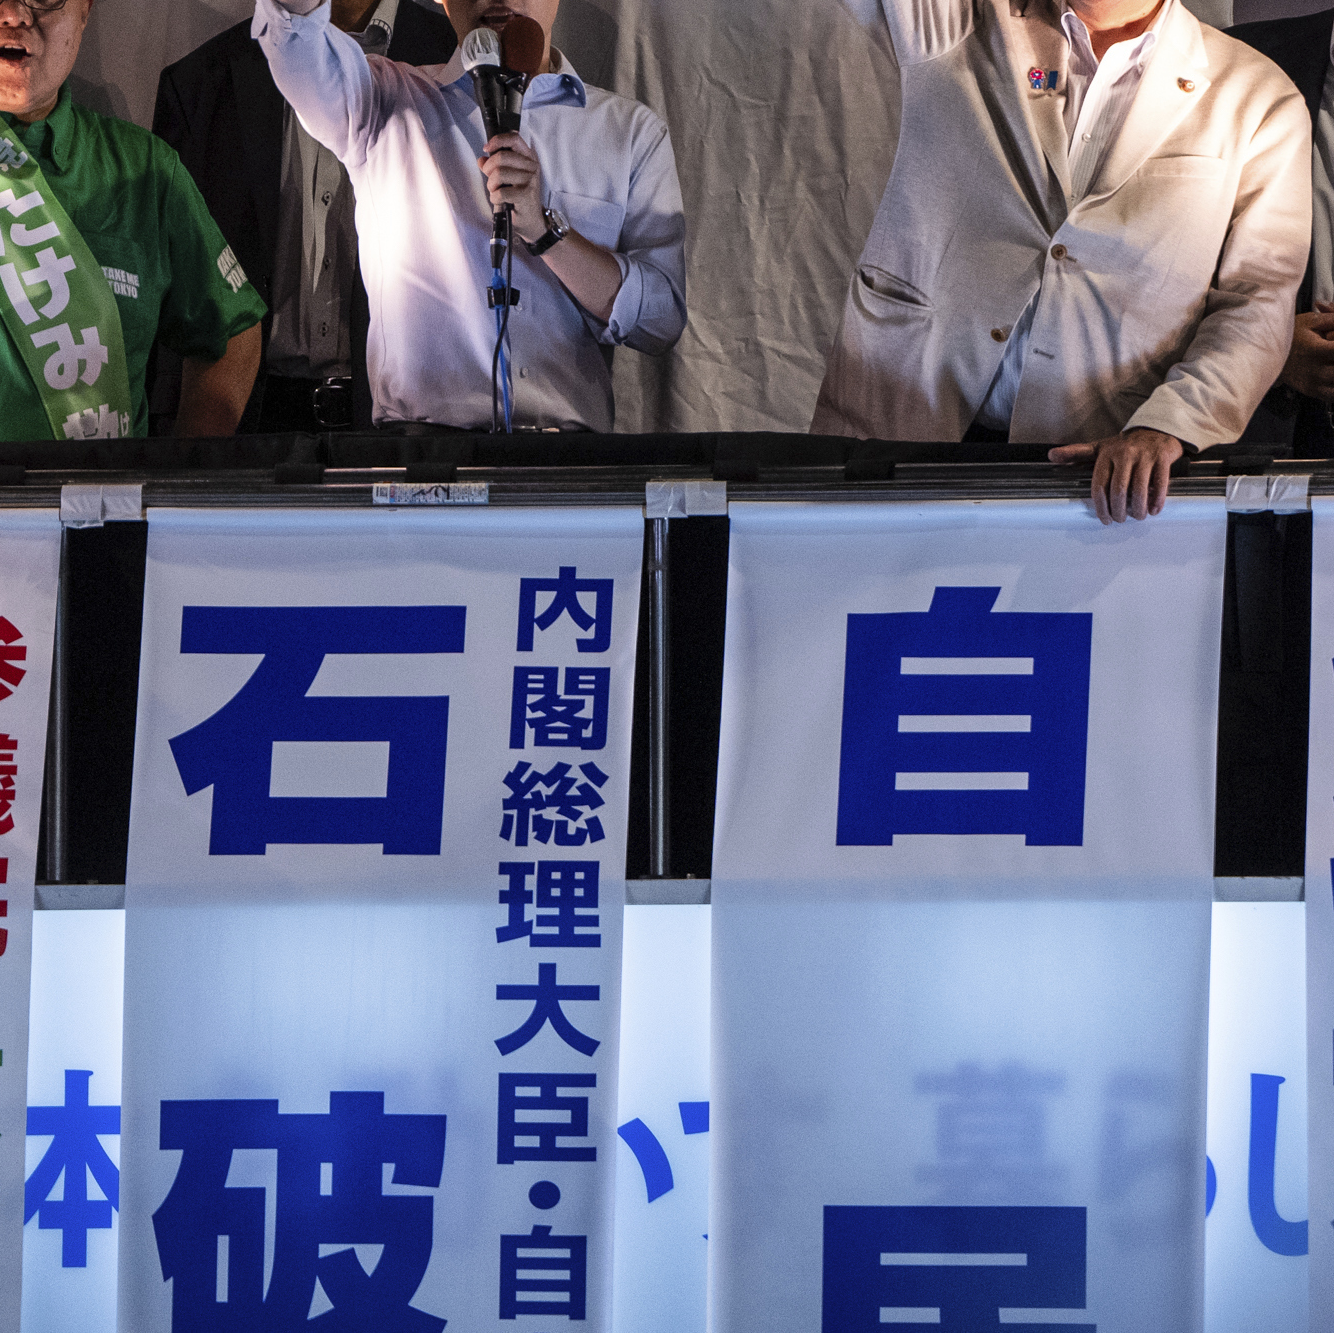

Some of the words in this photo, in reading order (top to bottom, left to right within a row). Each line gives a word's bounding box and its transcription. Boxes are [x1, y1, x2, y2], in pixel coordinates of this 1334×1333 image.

[151, 605, 467, 1333] 石破
[495, 566, 614, 1321] 内閣総理大臣・自
